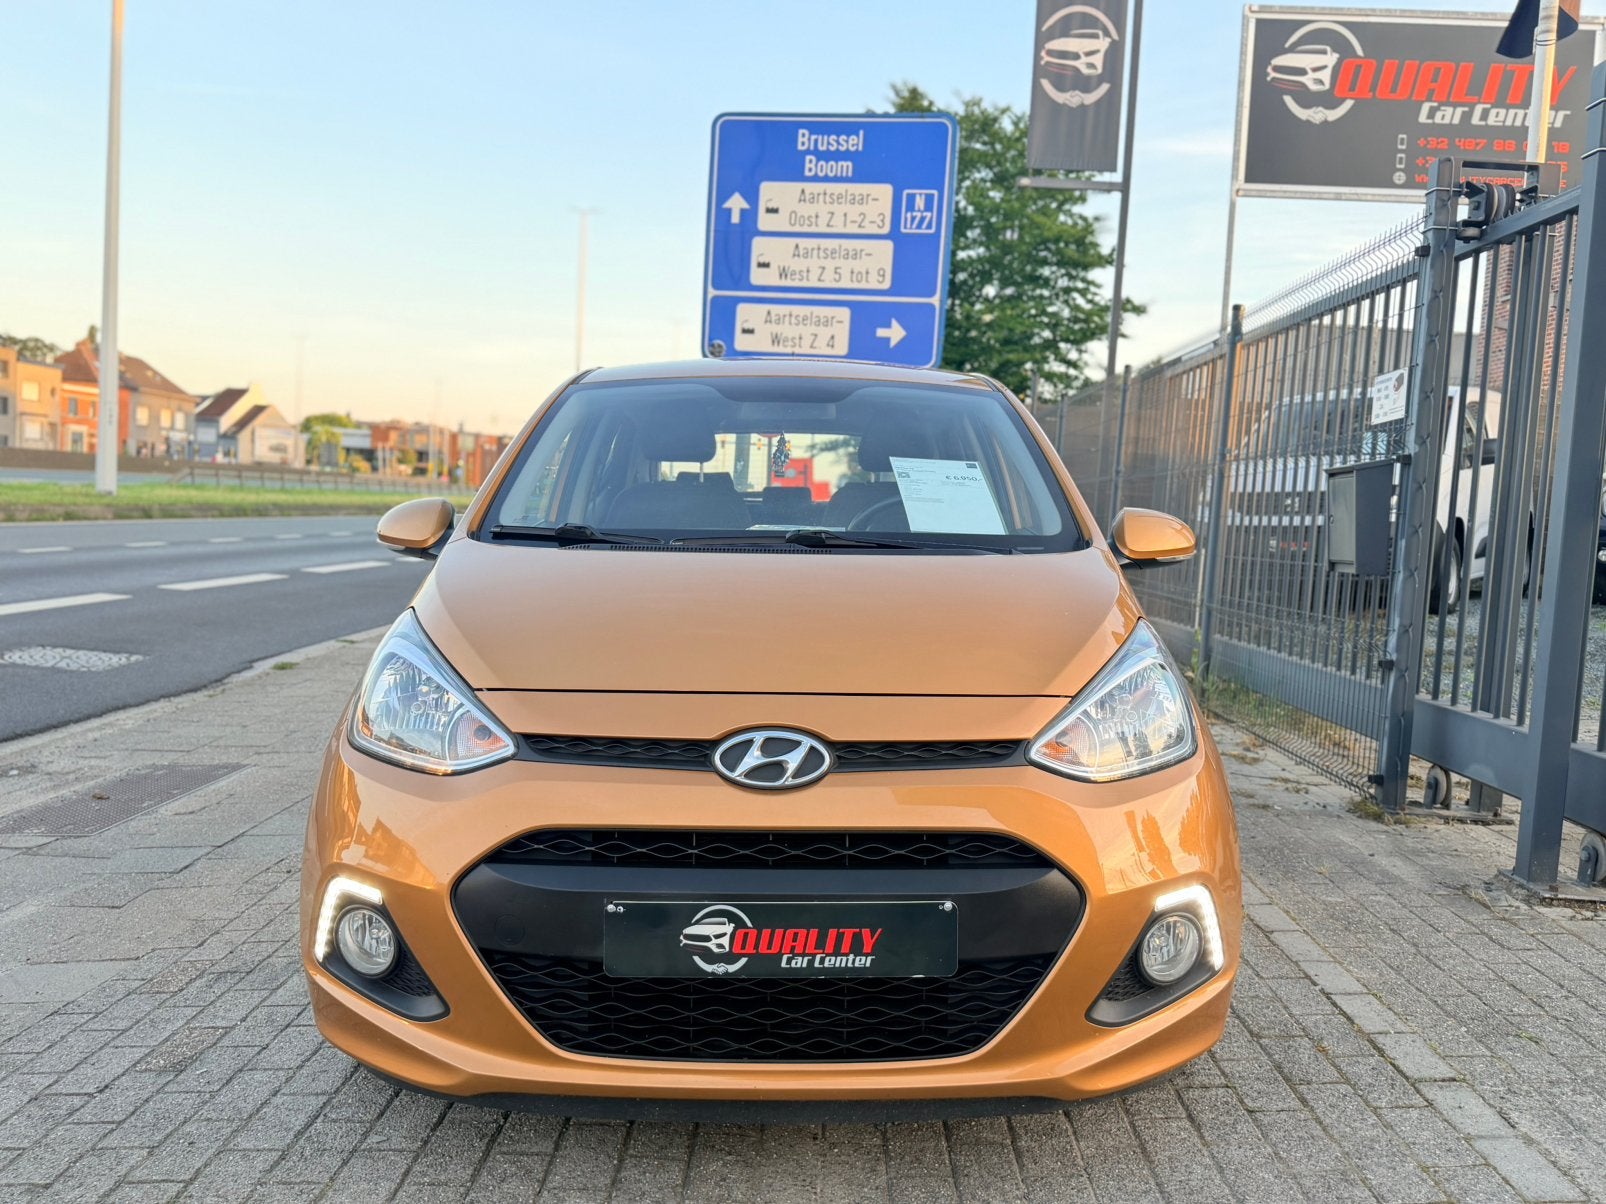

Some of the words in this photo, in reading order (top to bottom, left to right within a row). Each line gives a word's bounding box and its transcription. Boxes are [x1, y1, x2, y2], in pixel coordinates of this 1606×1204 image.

[1334, 57, 1578, 106] QUALITY
[1418, 102, 1469, 125] Car
[797, 129, 865, 152] Brussel
[1417, 137, 1449, 150] +32
[1455, 138, 1488, 151] 487
[1552, 141, 1571, 154] 18
[804, 155, 853, 178] Boom
[798, 188, 880, 206] Aartselaar-
[914, 194, 926, 211] N
[788, 210, 820, 228] Oost
[906, 212, 933, 230] 177
[792, 243, 873, 261] Aartselaar-
[777, 265, 811, 282] West
[850, 268, 871, 284] tot
[876, 267, 887, 285] 9
[764, 309, 844, 327] Aartselaar-
[770, 332, 803, 349] West
[826, 334, 836, 350] 4
[732, 928, 883, 954] QUALITY
[781, 954, 812, 968] Car
[813, 954, 875, 968] Center
